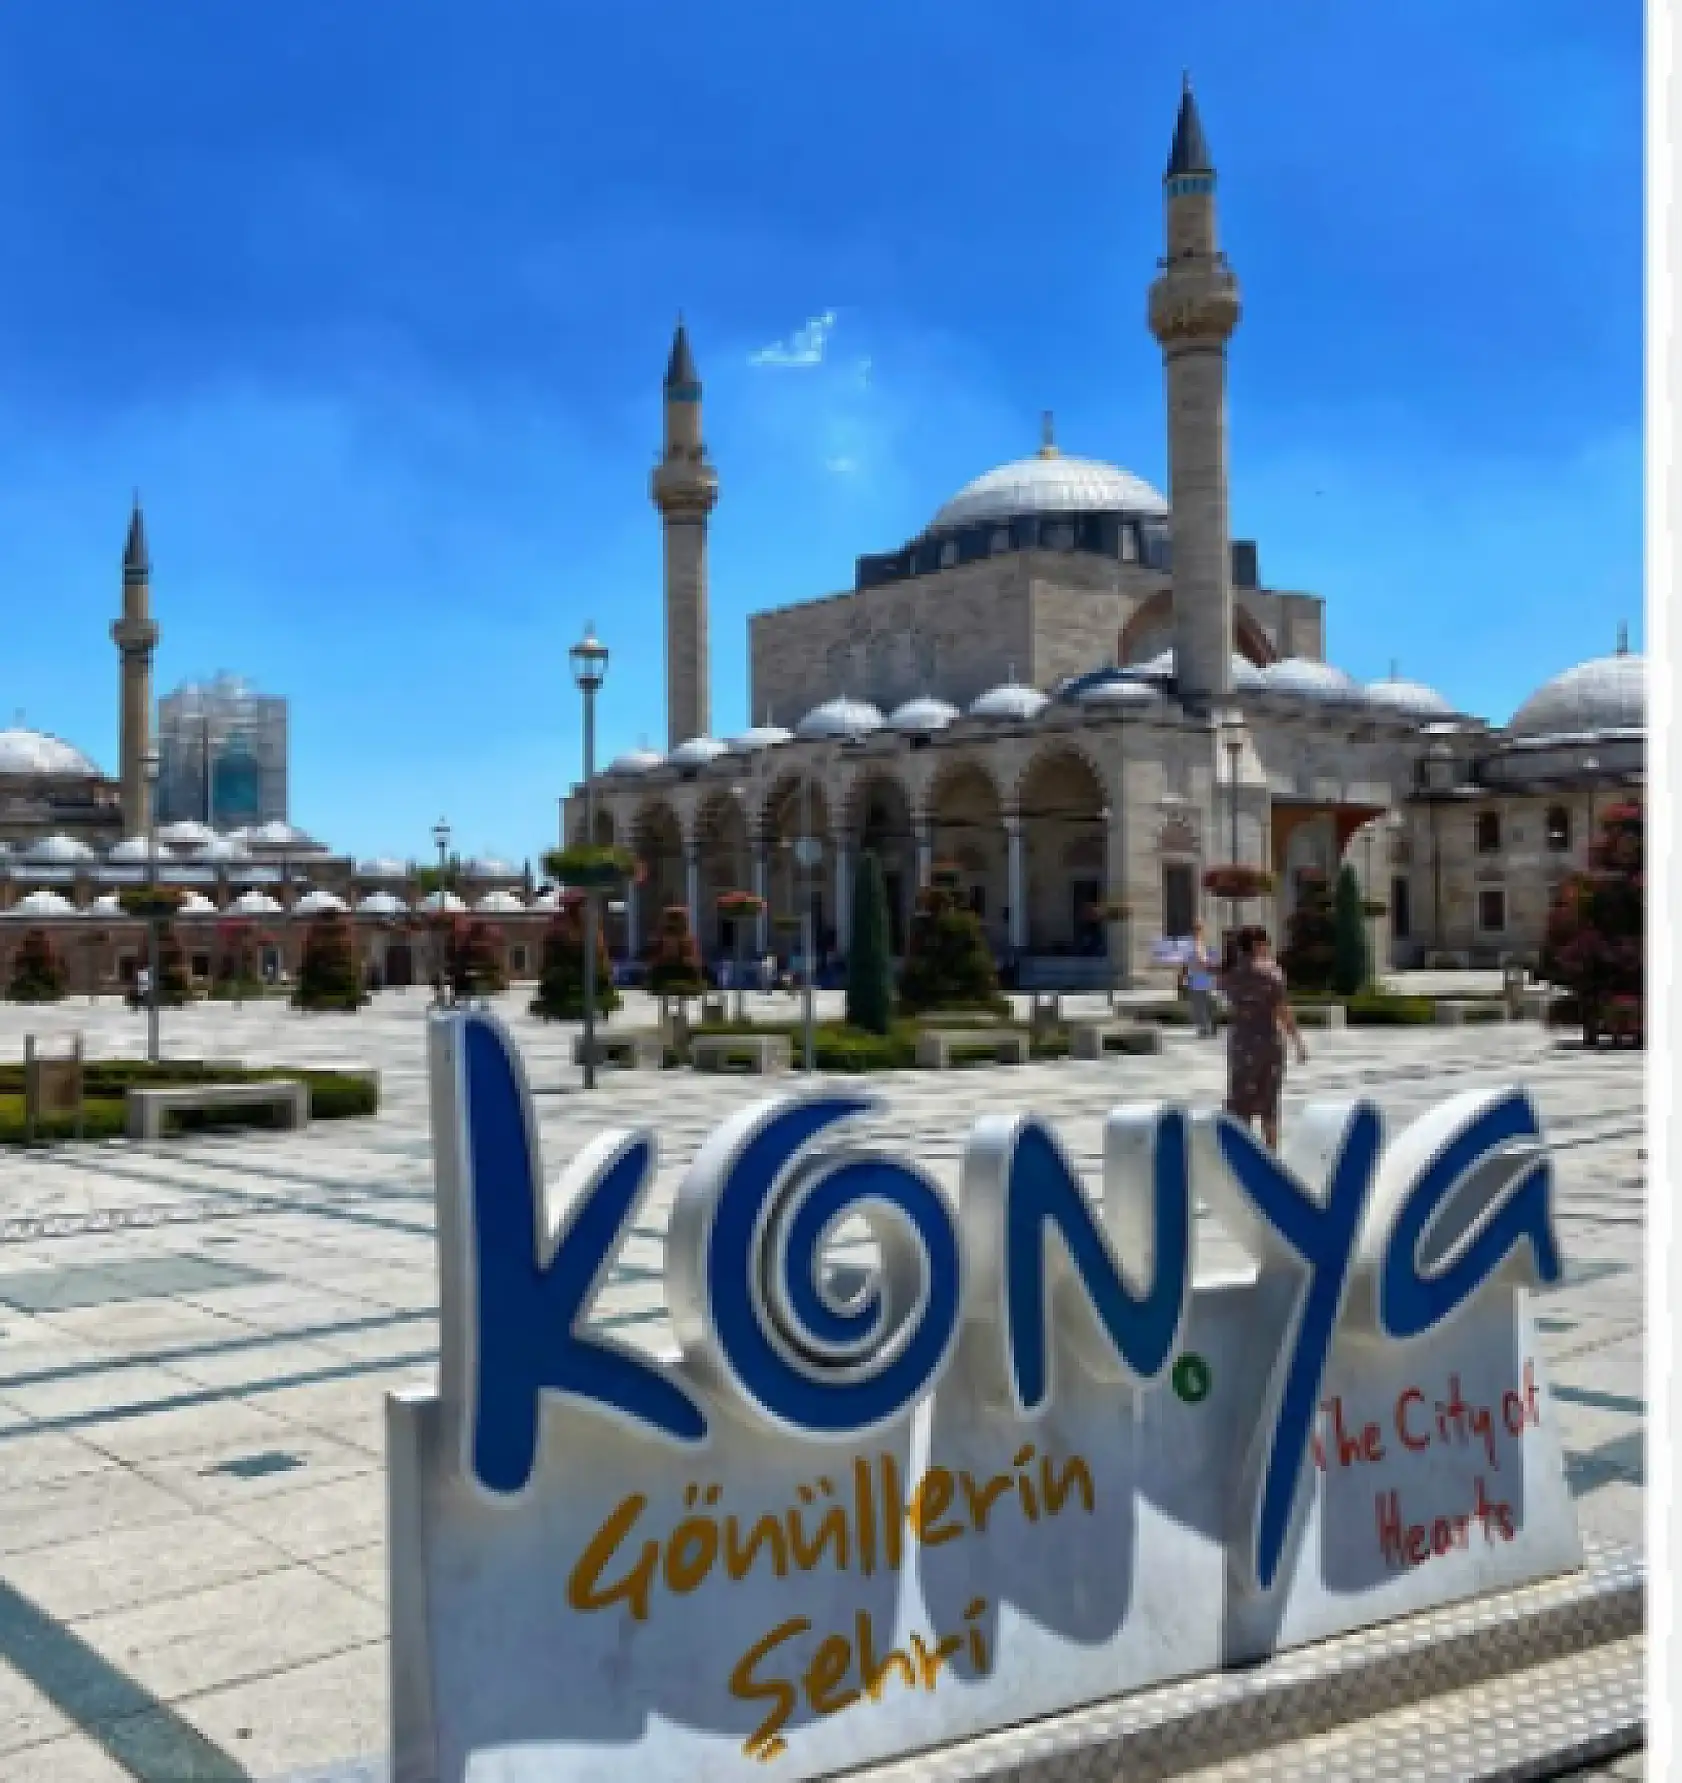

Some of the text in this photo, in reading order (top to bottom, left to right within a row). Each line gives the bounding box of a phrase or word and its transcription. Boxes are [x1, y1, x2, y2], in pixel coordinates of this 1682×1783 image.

[1394, 1371, 1499, 1471] City
[567, 1444, 1096, 1622] Gönüllerin
[1374, 1476, 1515, 1567] Hearts
[729, 1597, 994, 1764] Şehri
